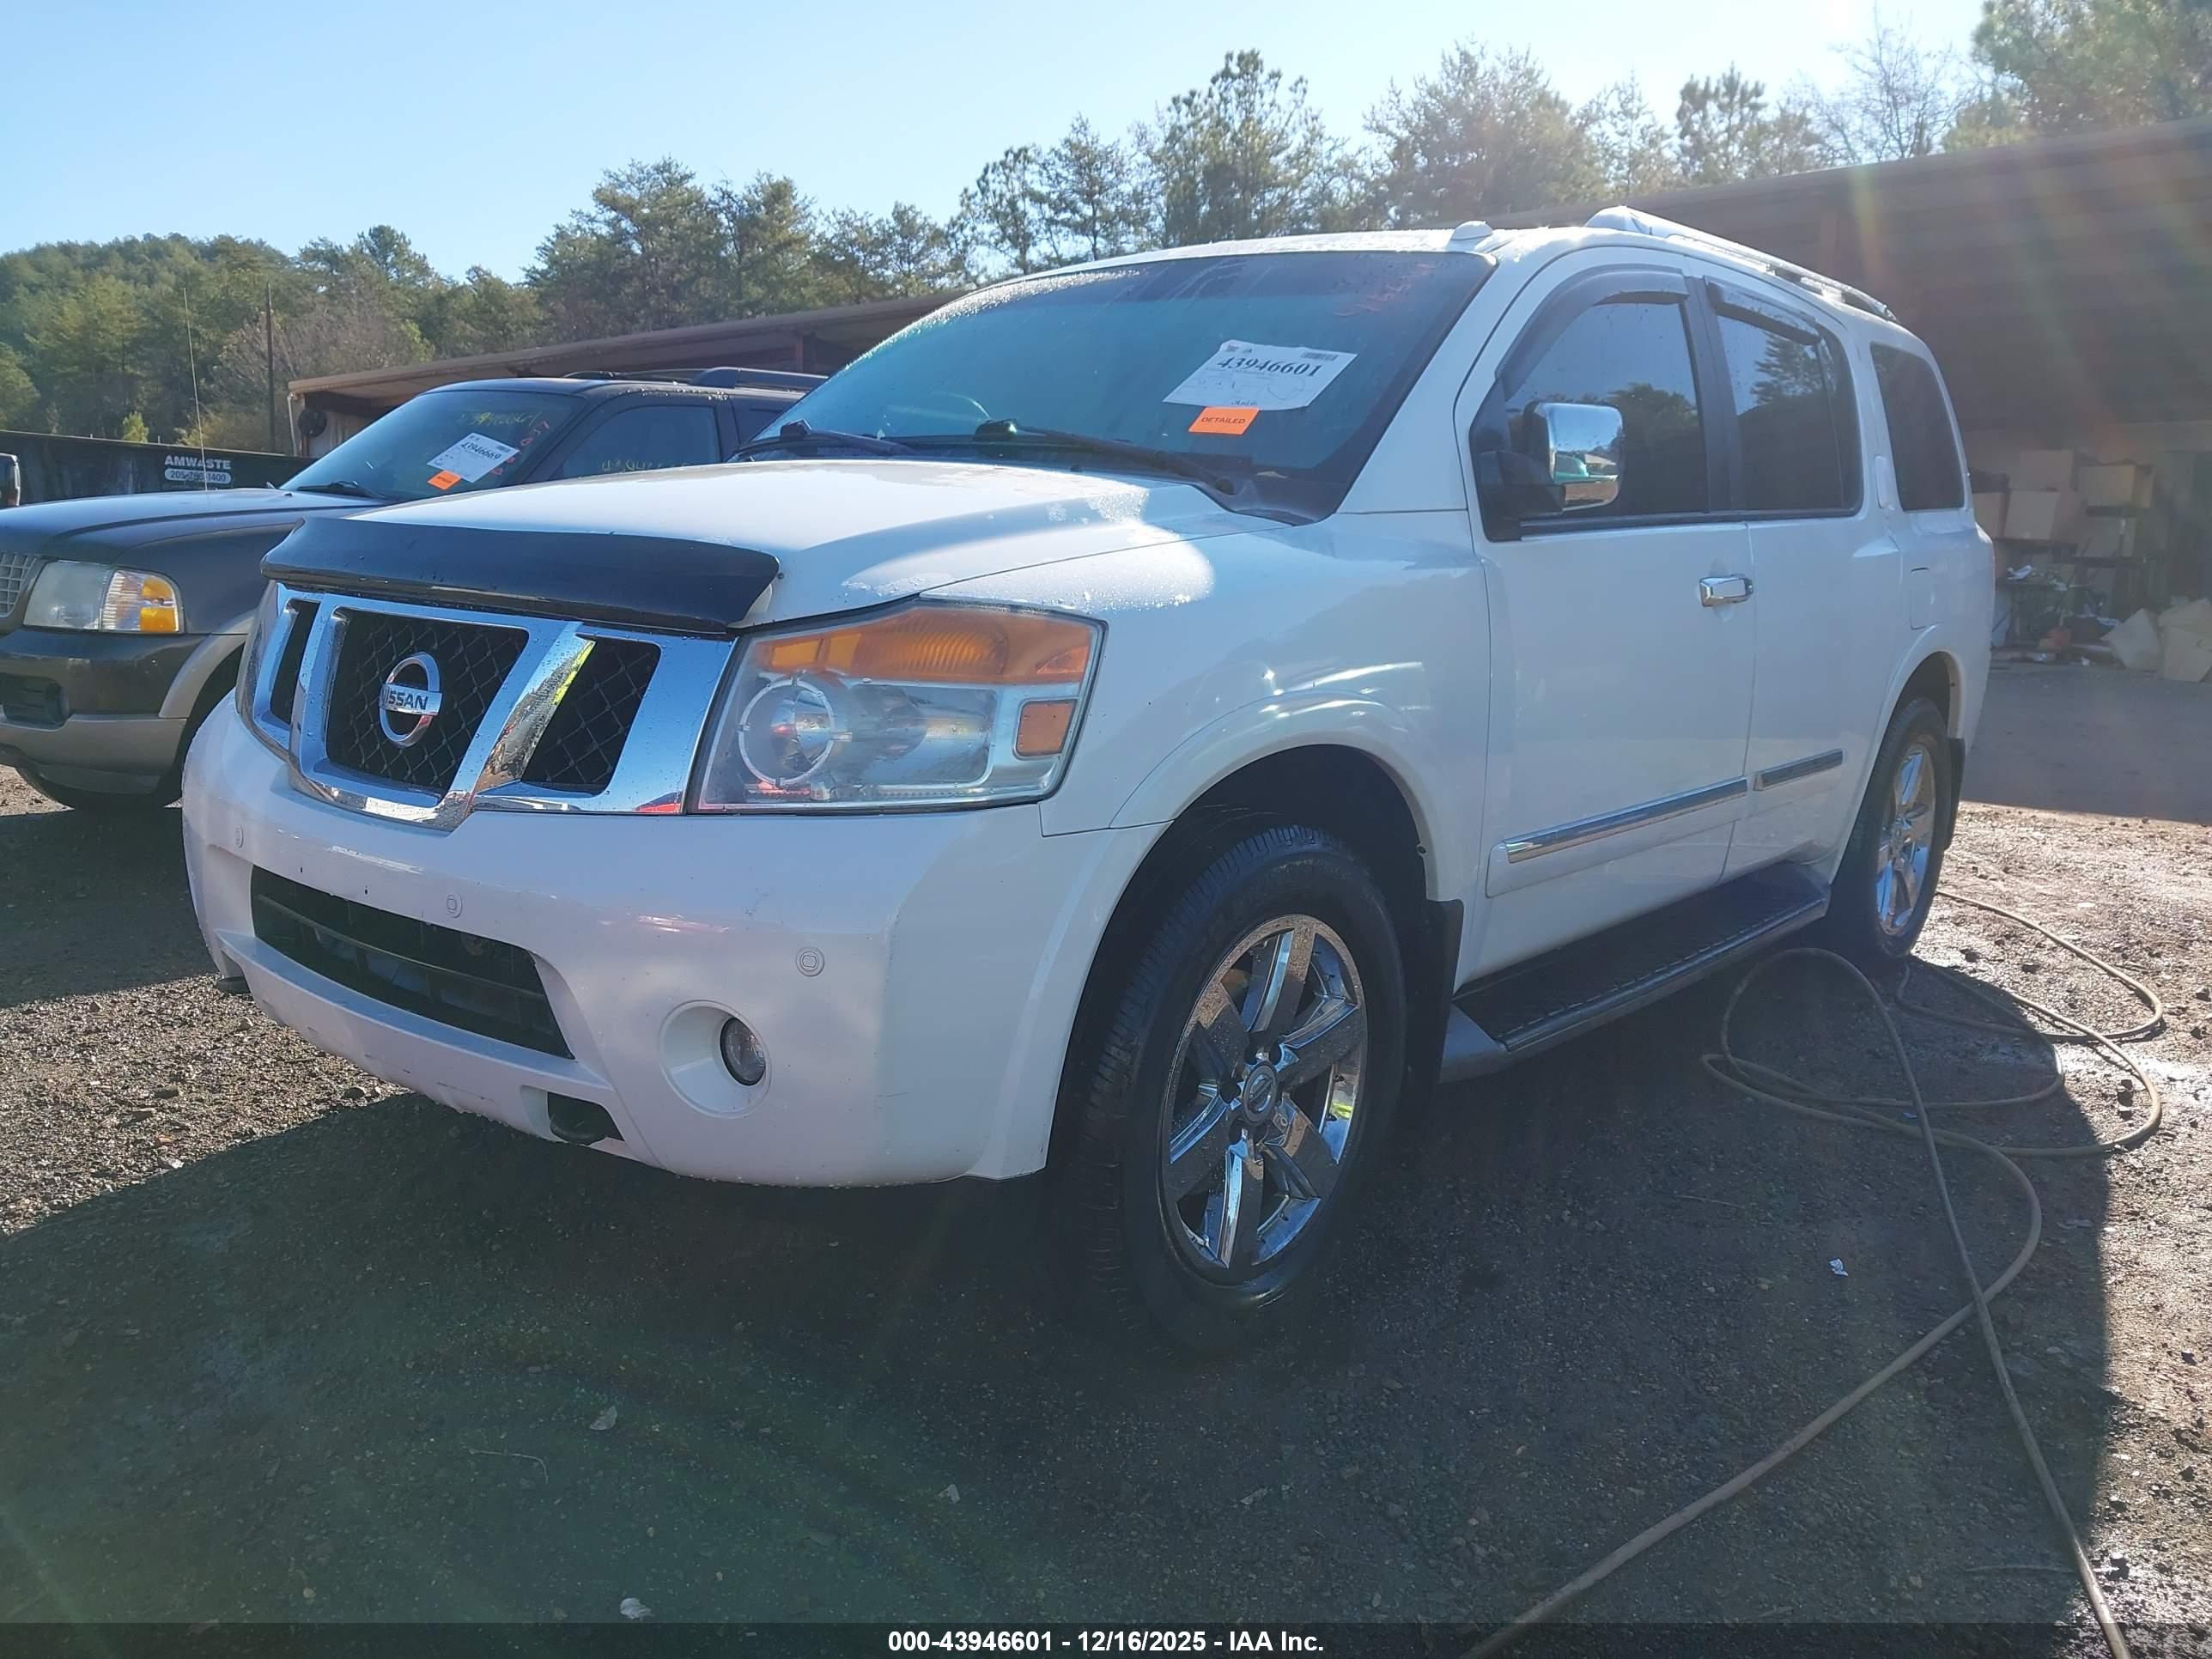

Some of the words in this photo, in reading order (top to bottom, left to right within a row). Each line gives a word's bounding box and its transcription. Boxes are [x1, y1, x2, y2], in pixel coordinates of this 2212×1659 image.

[1217, 357, 1323, 377] 43946601
[1200, 416, 1247, 425] DETAILED
[164, 454, 232, 470] AMWASTE
[381, 688, 428, 710] NISSAN
